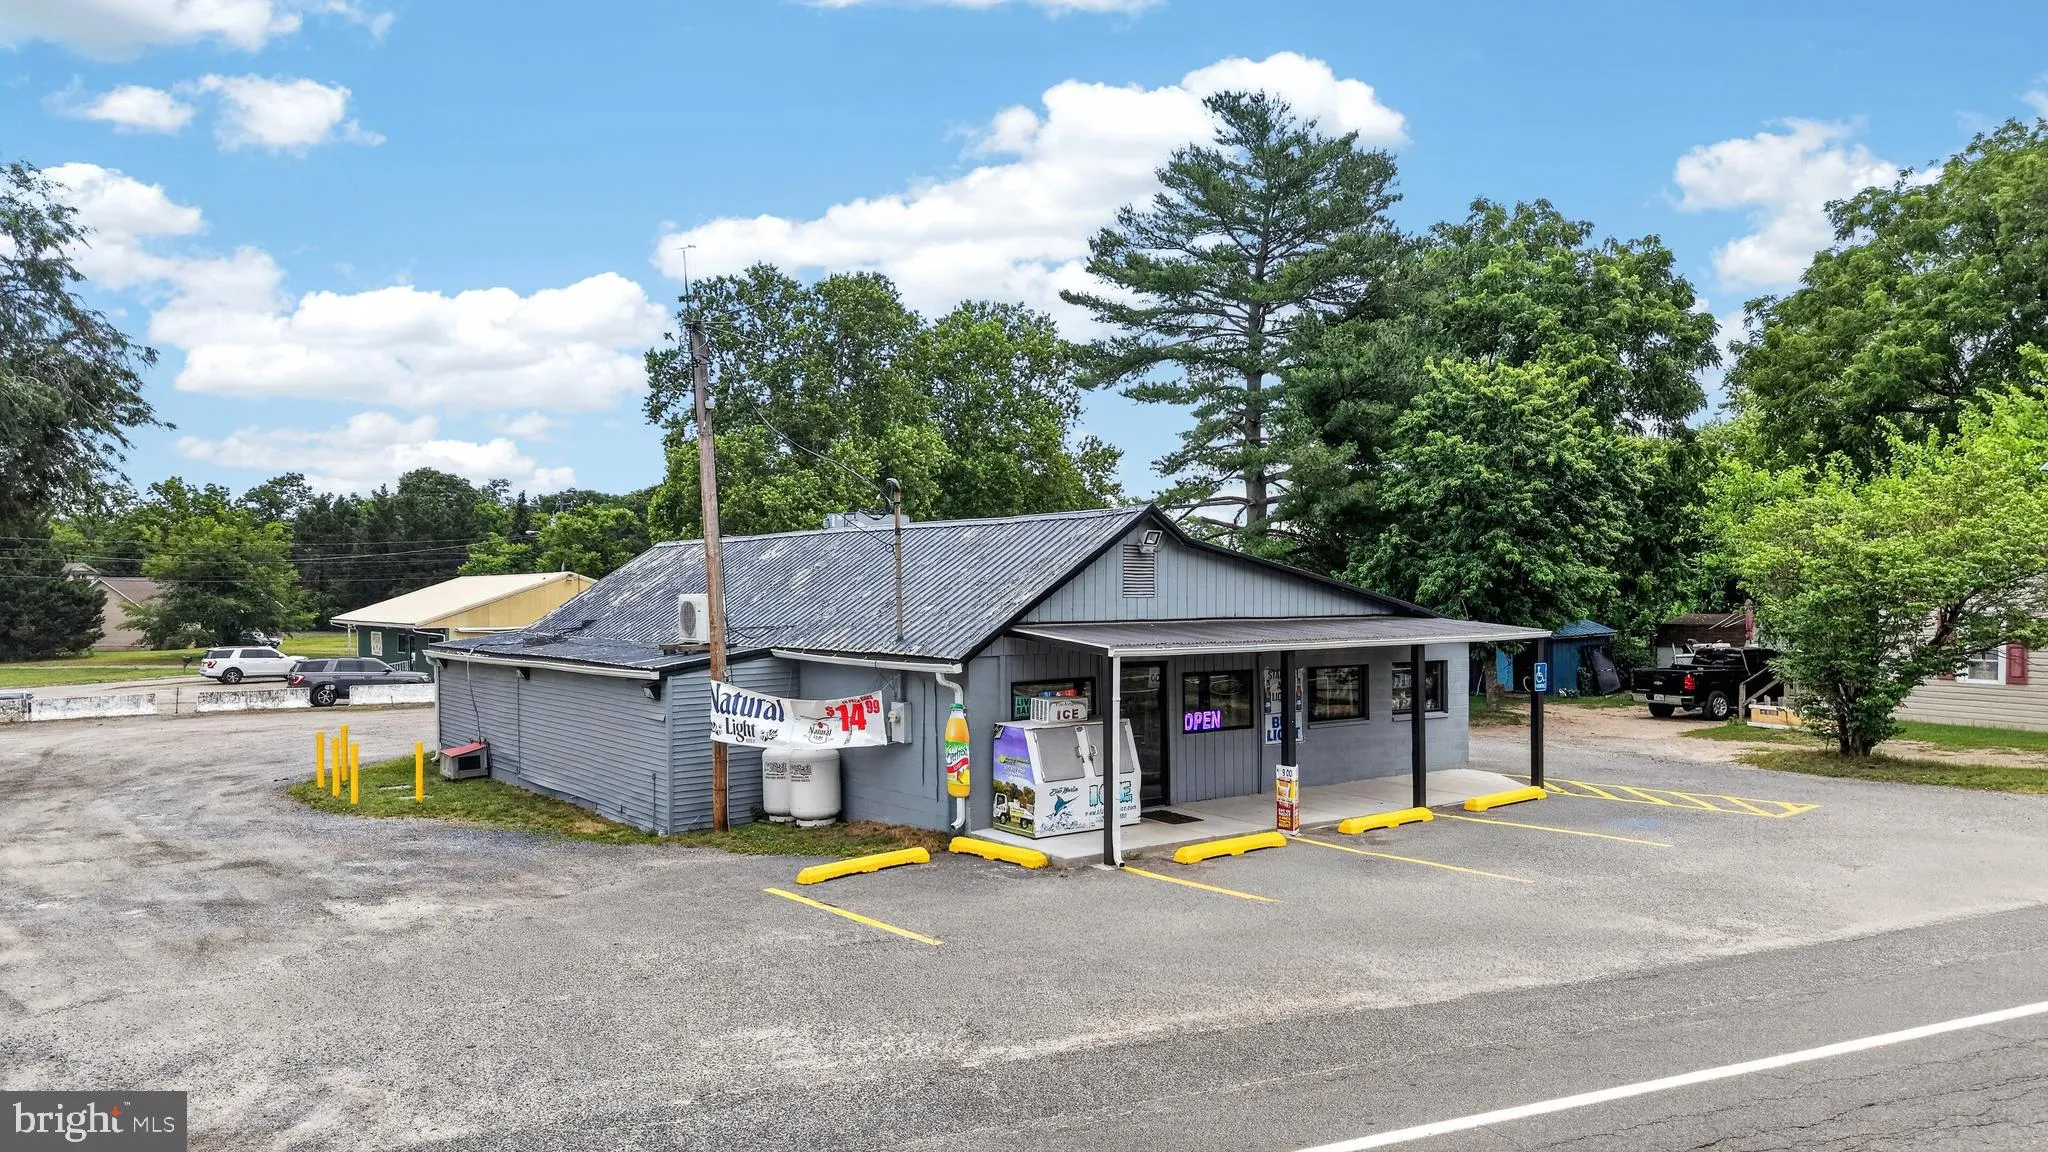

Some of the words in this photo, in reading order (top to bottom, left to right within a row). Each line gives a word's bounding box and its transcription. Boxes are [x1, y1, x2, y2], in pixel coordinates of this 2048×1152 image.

[711, 683, 785, 723] Natural
[1056, 708, 1079, 720] ICE
[725, 717, 756, 743] Light
[1184, 710, 1221, 731] OPEN
